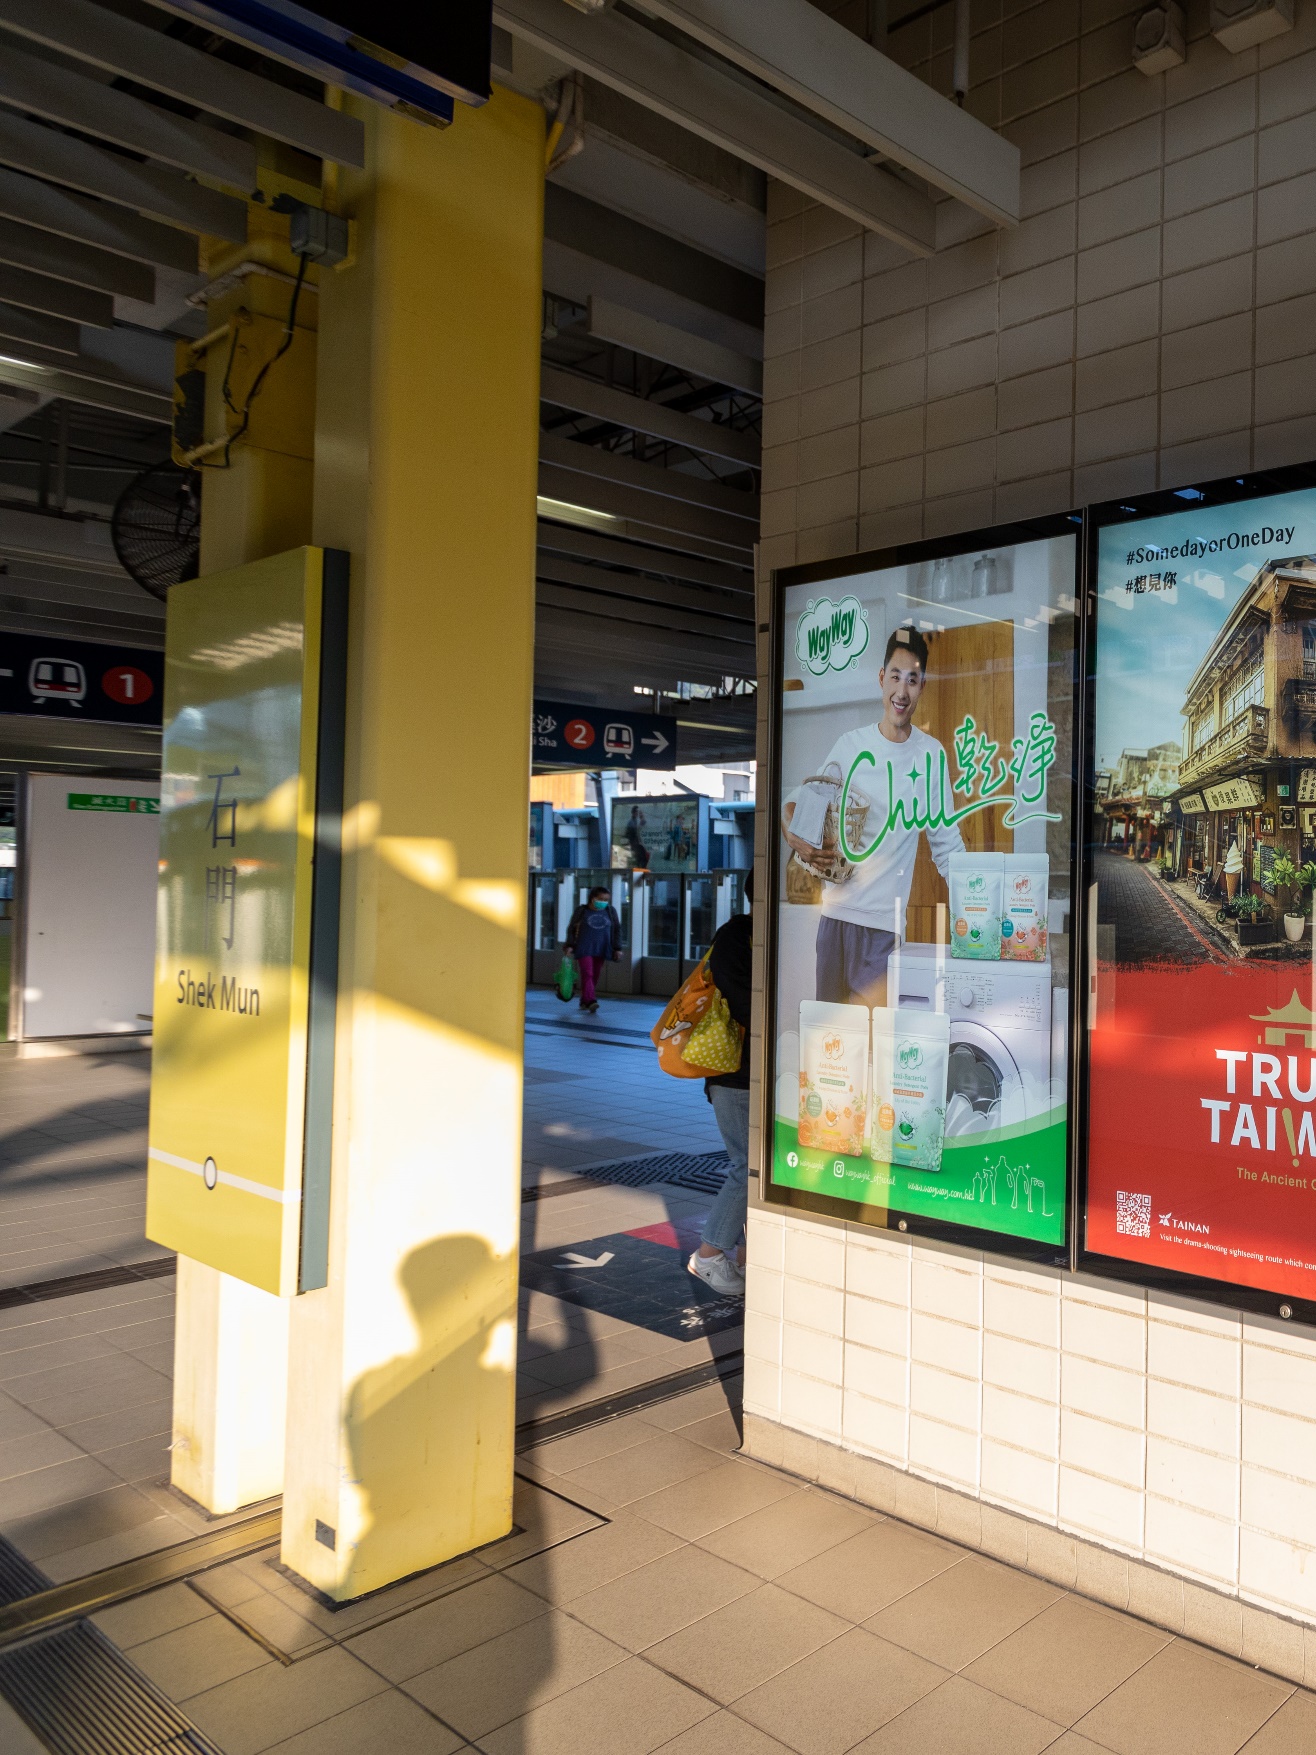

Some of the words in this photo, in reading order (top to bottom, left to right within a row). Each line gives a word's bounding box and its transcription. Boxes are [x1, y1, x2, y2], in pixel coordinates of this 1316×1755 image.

[1126, 524, 1296, 566] #SomedayorOneDay
[1125, 571, 1177, 595] #想見你
[807, 608, 855, 662] WayWay
[119, 674, 133, 698] 1
[533, 715, 557, 735] 沙
[573, 724, 587, 744] 2
[538, 737, 557, 747] Sha
[839, 750, 962, 862] Chill
[205, 765, 240, 950] 石門
[177, 969, 216, 1010] Shek
[220, 975, 260, 1016] Mun
[1237, 1167, 1258, 1182] The
[1261, 1171, 1307, 1188] Ancient
[1172, 1219, 1210, 1234] TAINAN
[1160, 1233, 1172, 1242] Visit
[1184, 1238, 1227, 1255] drama-shooting
[1230, 1248, 1263, 1262] sightseeing
[1266, 1255, 1282, 1263] route
[1285, 1258, 1303, 1267] which
